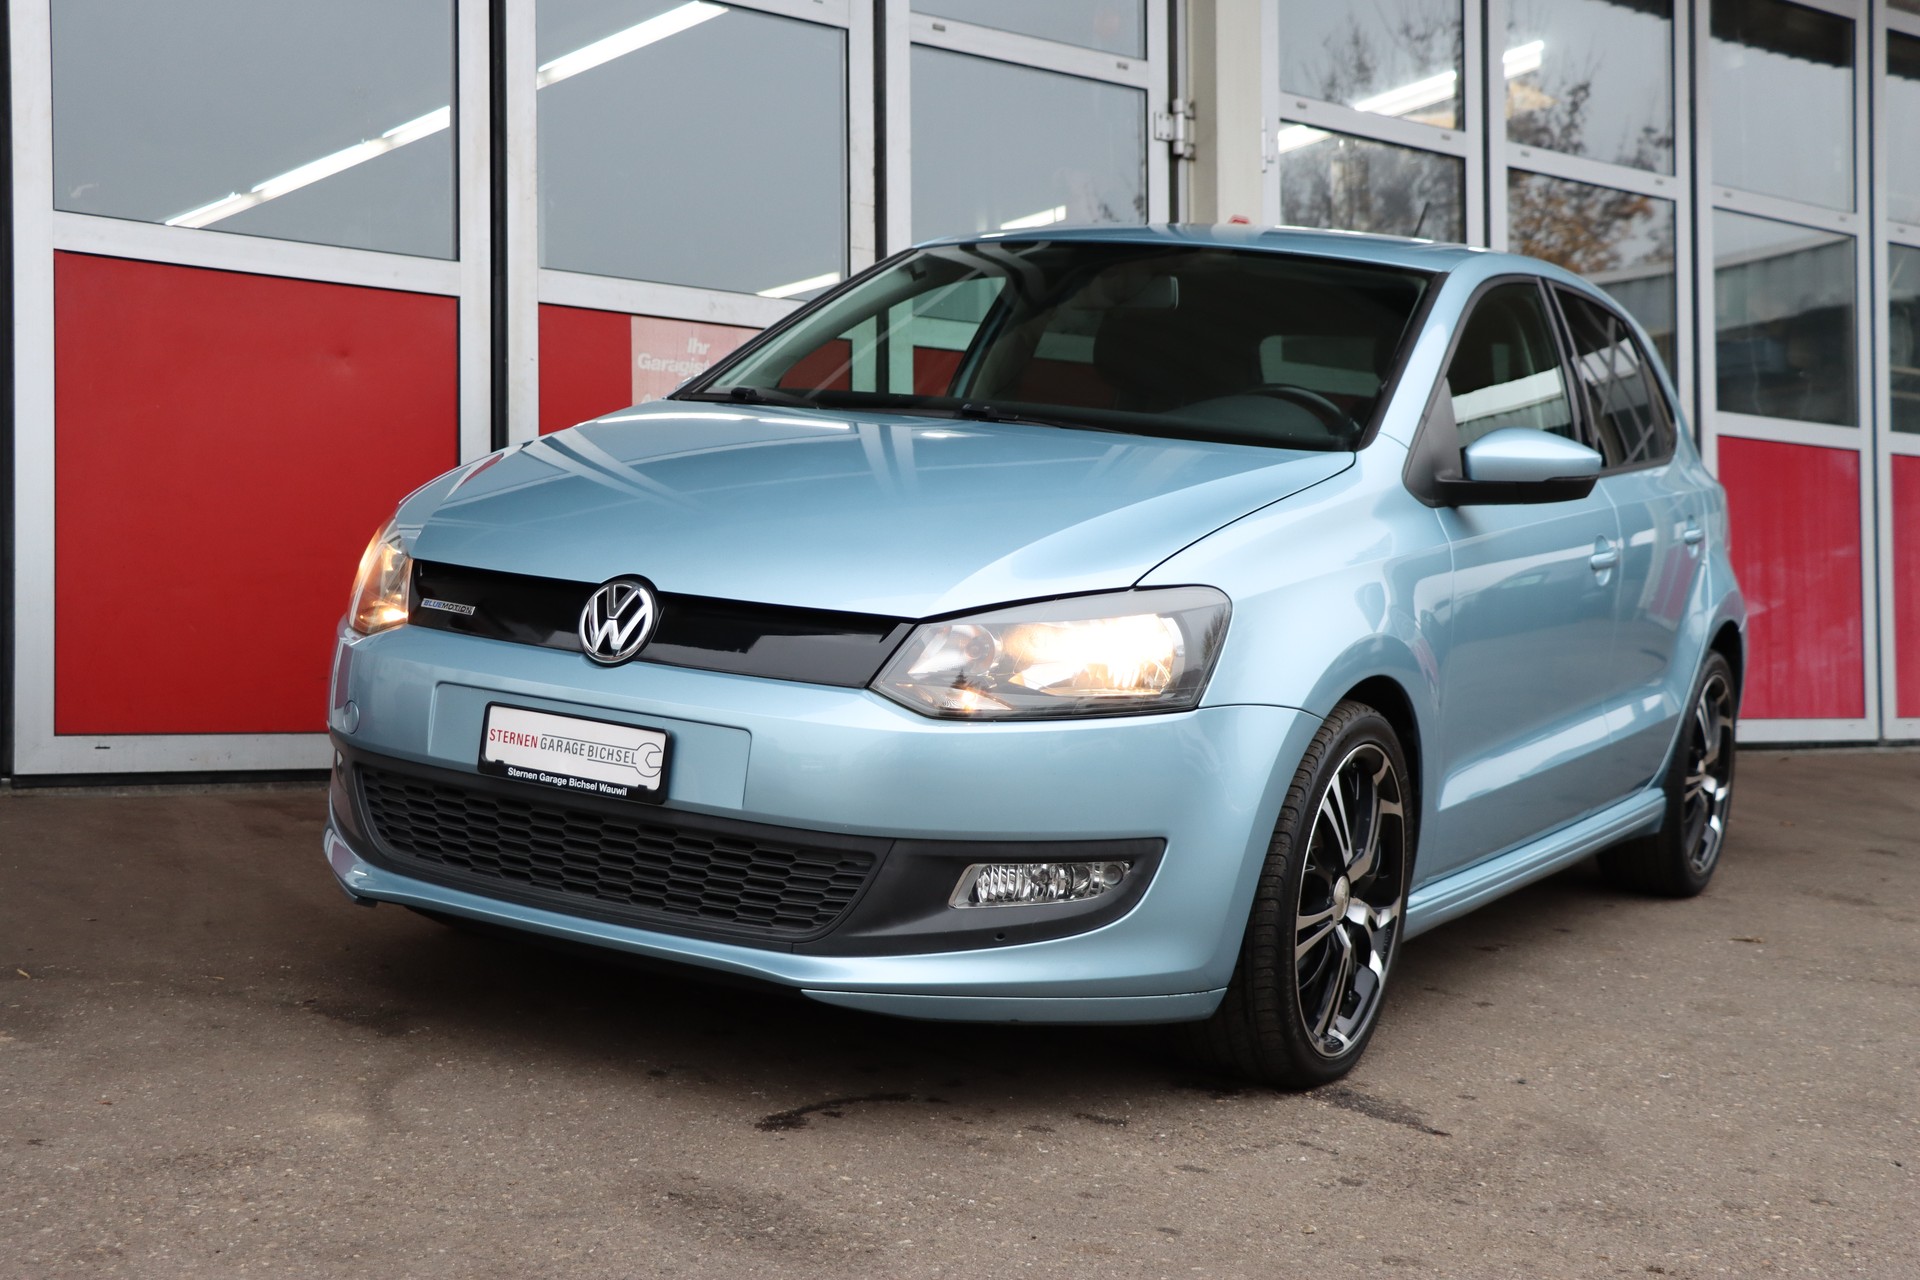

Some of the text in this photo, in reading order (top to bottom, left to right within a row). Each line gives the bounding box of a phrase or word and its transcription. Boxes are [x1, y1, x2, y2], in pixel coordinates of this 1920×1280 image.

[687, 337, 710, 355] Ihr
[423, 599, 473, 614] BLUEMOTION
[489, 728, 637, 765] STERNEN GARAGE BICHSEL
[507, 767, 628, 796] Sternen Garage Bichsel Wauwil
